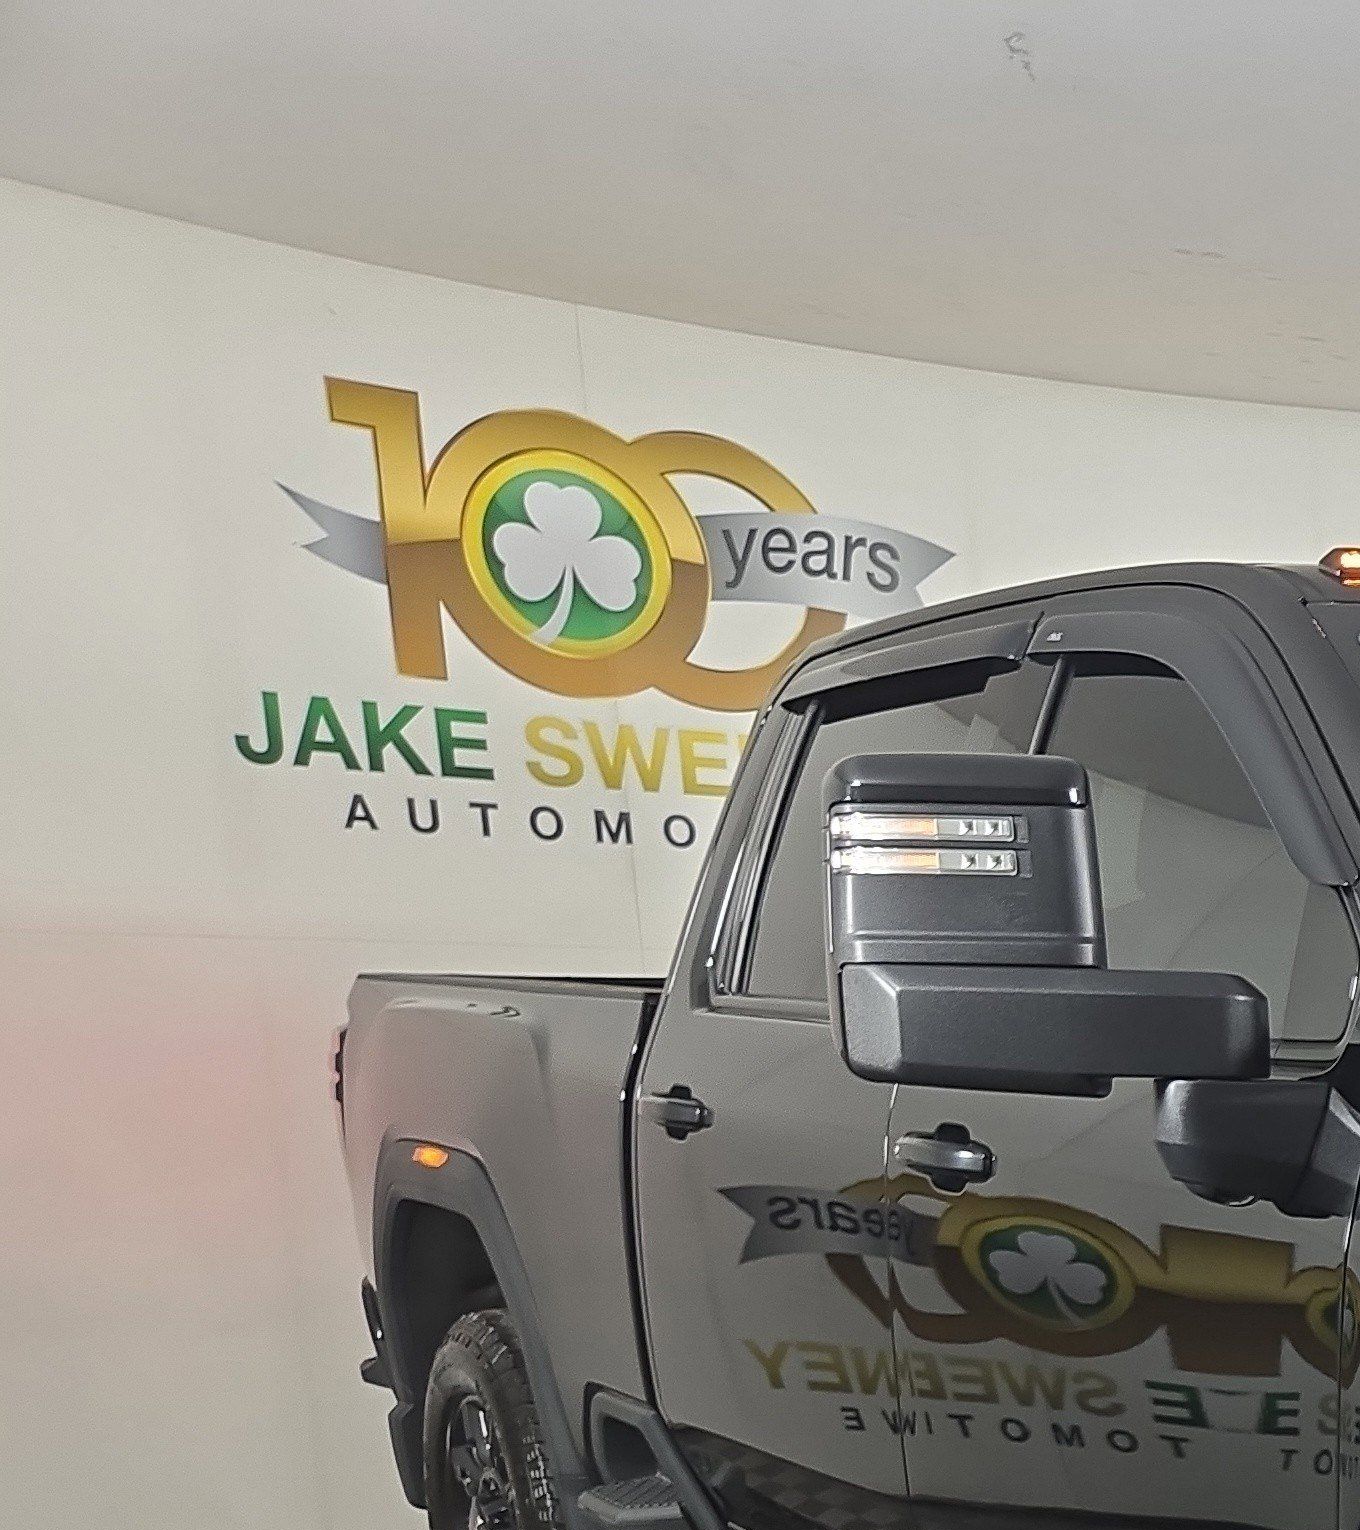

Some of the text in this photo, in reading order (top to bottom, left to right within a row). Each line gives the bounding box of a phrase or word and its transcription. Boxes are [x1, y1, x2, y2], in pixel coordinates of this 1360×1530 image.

[721, 526, 901, 594] years
[234, 690, 752, 797] JAKE SWE
